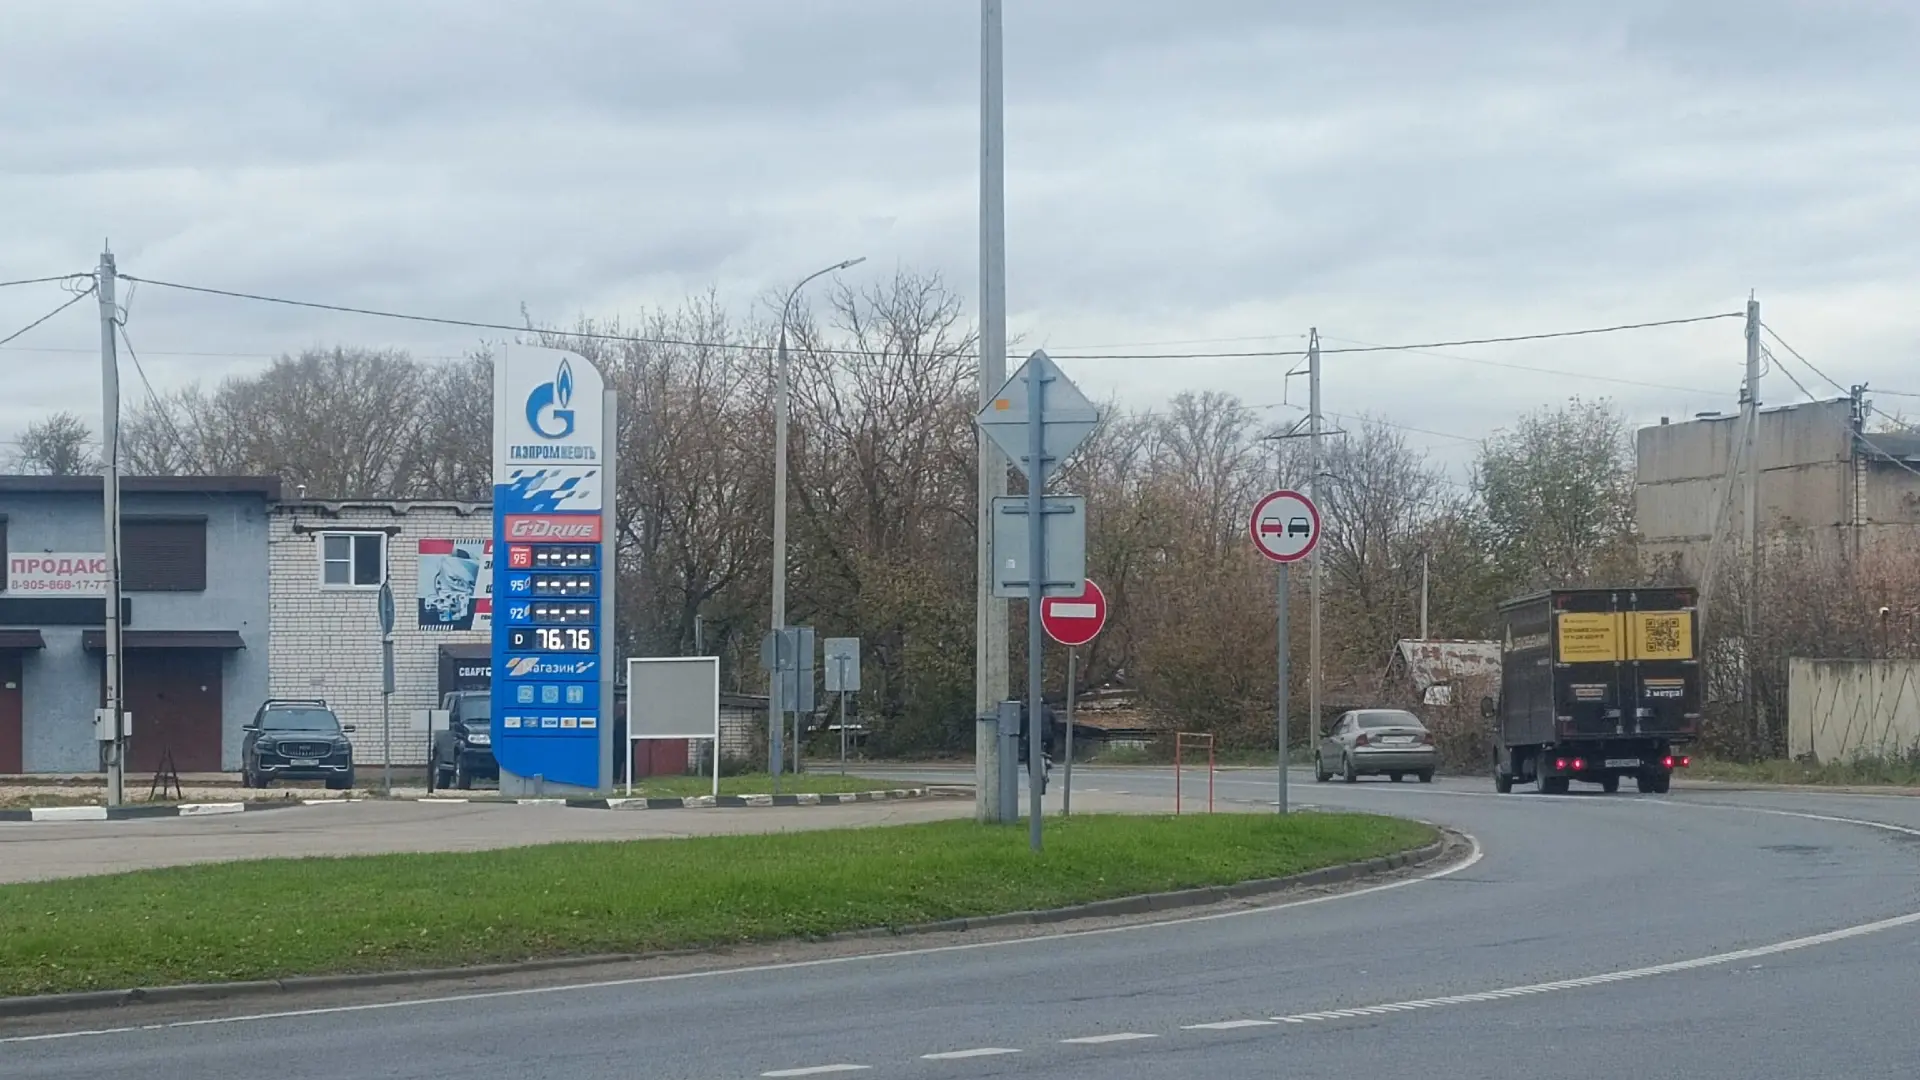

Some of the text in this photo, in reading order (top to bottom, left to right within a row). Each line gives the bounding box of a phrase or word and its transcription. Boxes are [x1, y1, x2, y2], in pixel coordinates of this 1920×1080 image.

[510, 445, 597, 460] ГАЗПРОМНЕФТЬ
[513, 553, 527, 565] 95
[11, 558, 107, 576] ПРОДАЮ
[510, 580, 524, 591] 95
[510, 607, 524, 620] 92
[514, 628, 590, 650] D 76.76
